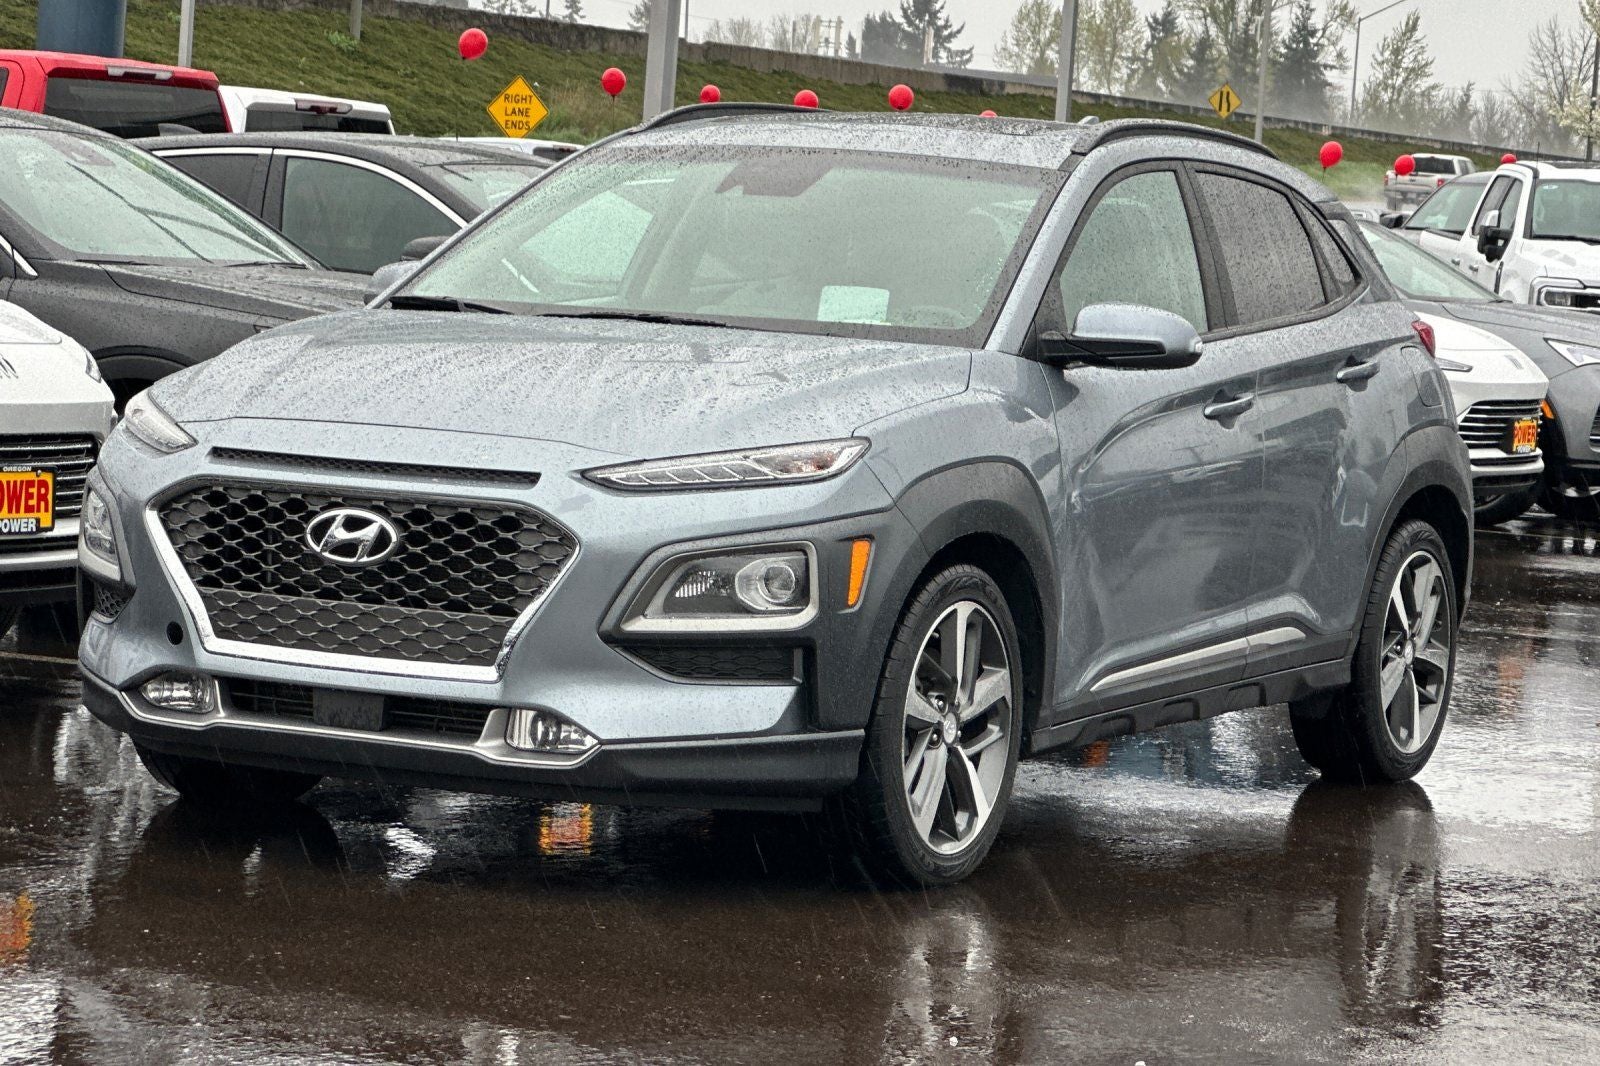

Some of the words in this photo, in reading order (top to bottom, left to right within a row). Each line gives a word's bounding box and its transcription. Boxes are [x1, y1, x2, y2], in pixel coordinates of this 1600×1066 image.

[503, 93, 534, 105] RIGHT
[504, 106, 531, 118] LANE
[504, 119, 531, 131] ENDS
[0, 518, 37, 533] OWER
